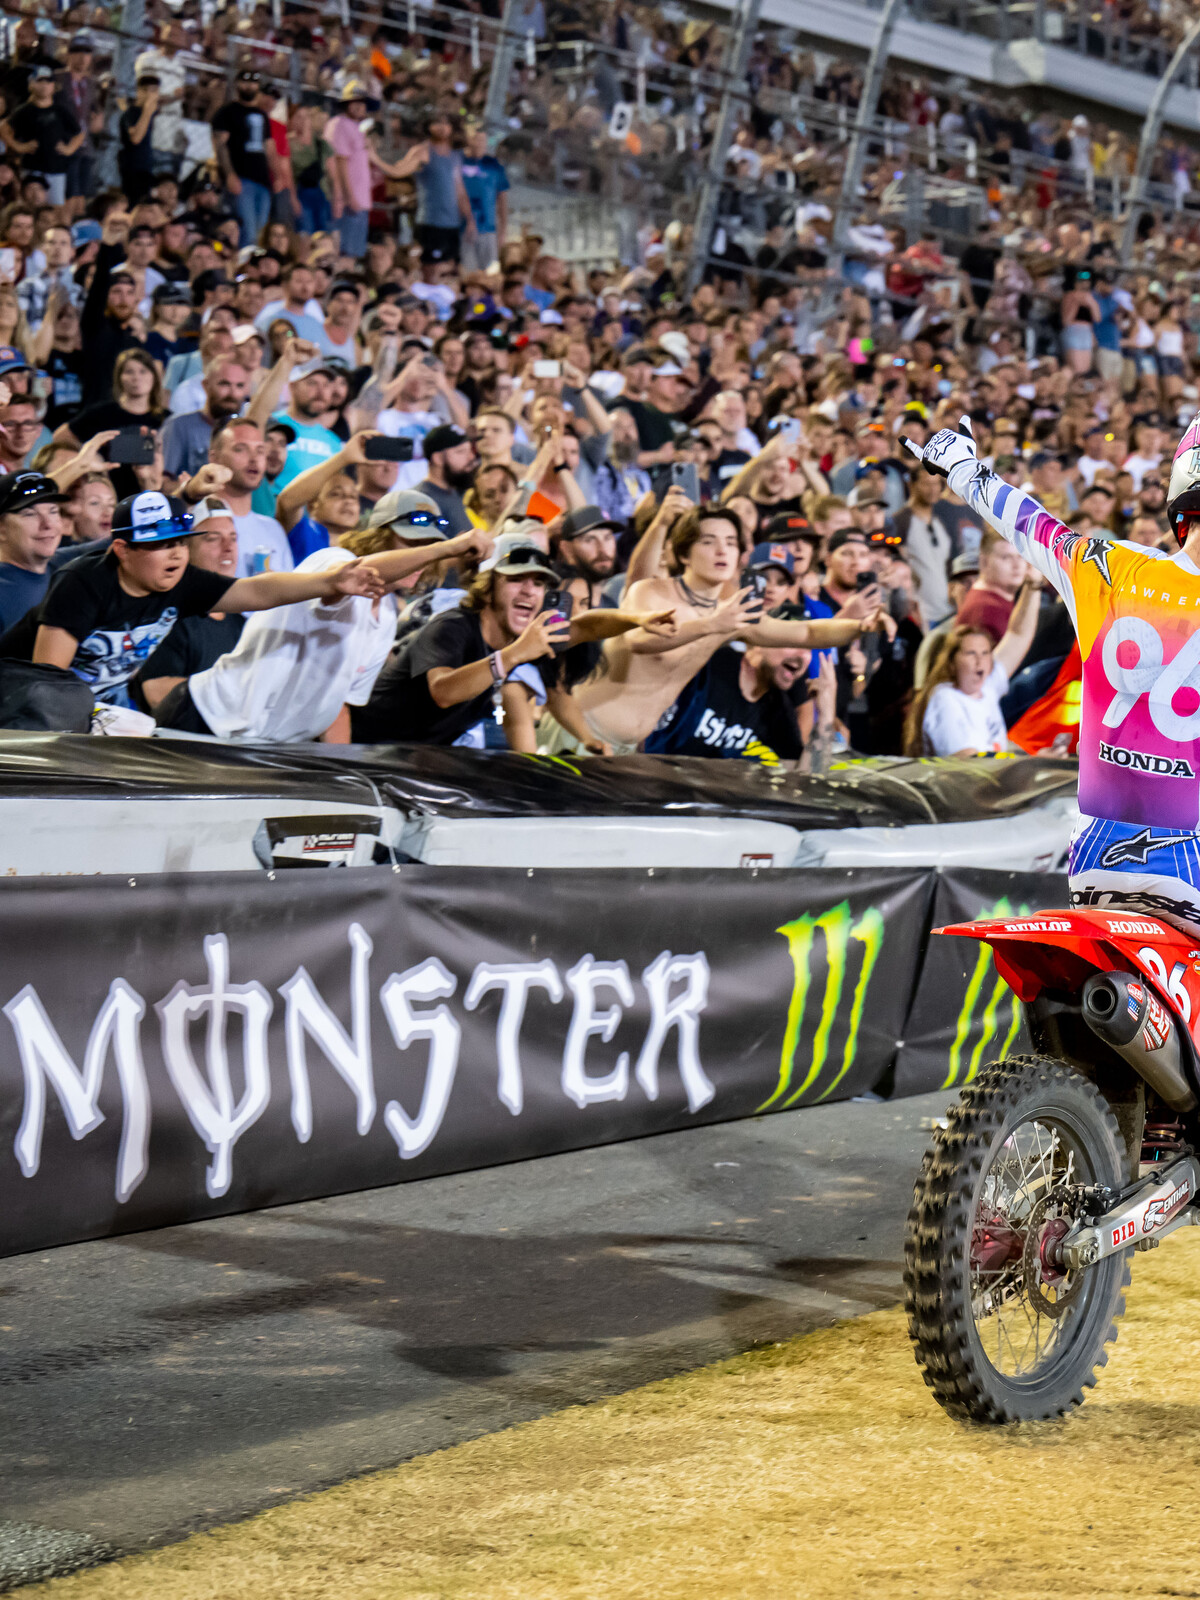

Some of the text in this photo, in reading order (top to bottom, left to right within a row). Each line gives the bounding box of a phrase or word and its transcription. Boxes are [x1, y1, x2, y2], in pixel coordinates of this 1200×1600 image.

[1099, 741, 1195, 779] HONDA
[1004, 921, 1072, 932] DUNLOP
[1106, 920, 1166, 935] HONDA
[1136, 946, 1192, 1024] 96
